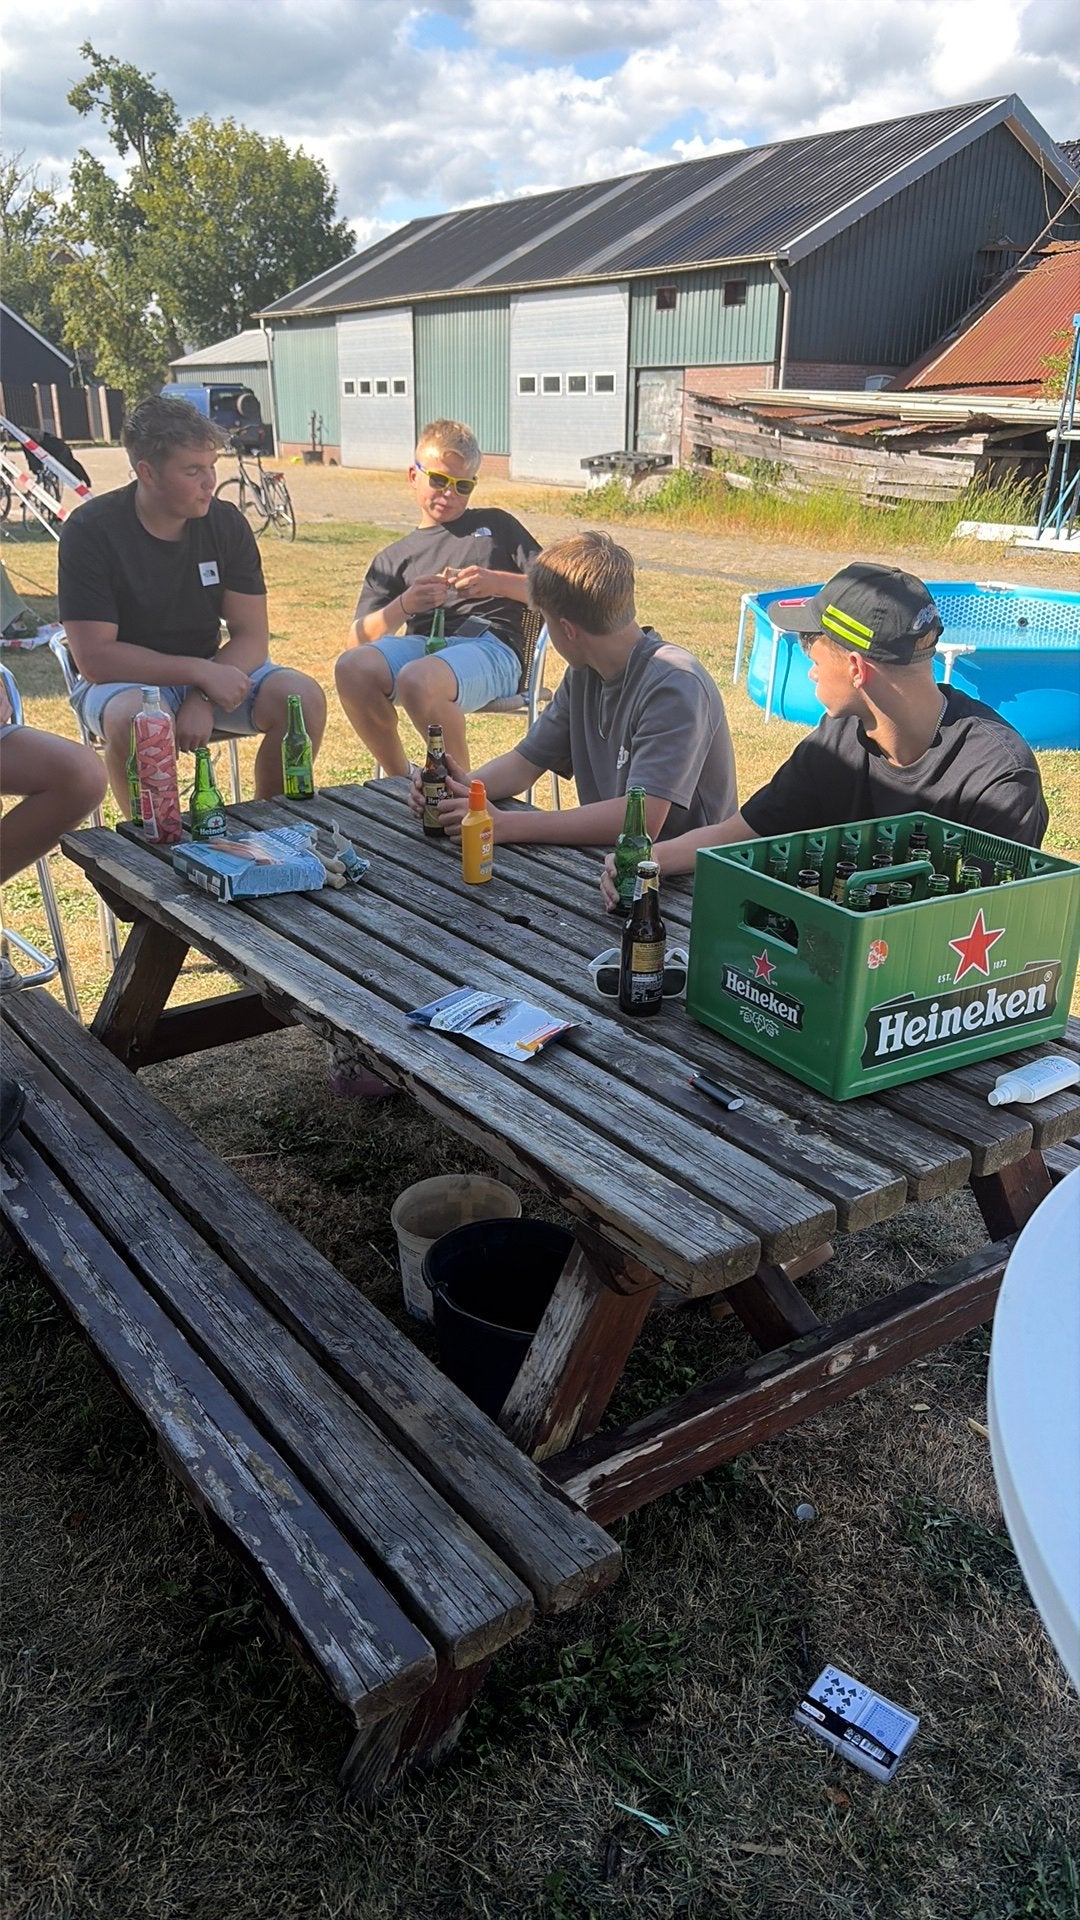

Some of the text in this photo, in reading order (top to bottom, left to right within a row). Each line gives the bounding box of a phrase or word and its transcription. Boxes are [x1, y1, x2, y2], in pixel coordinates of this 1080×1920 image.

[726, 970, 799, 1024] Heineken
[938, 960, 1007, 983] EST. 1873
[875, 983, 1047, 1057] Heineken
